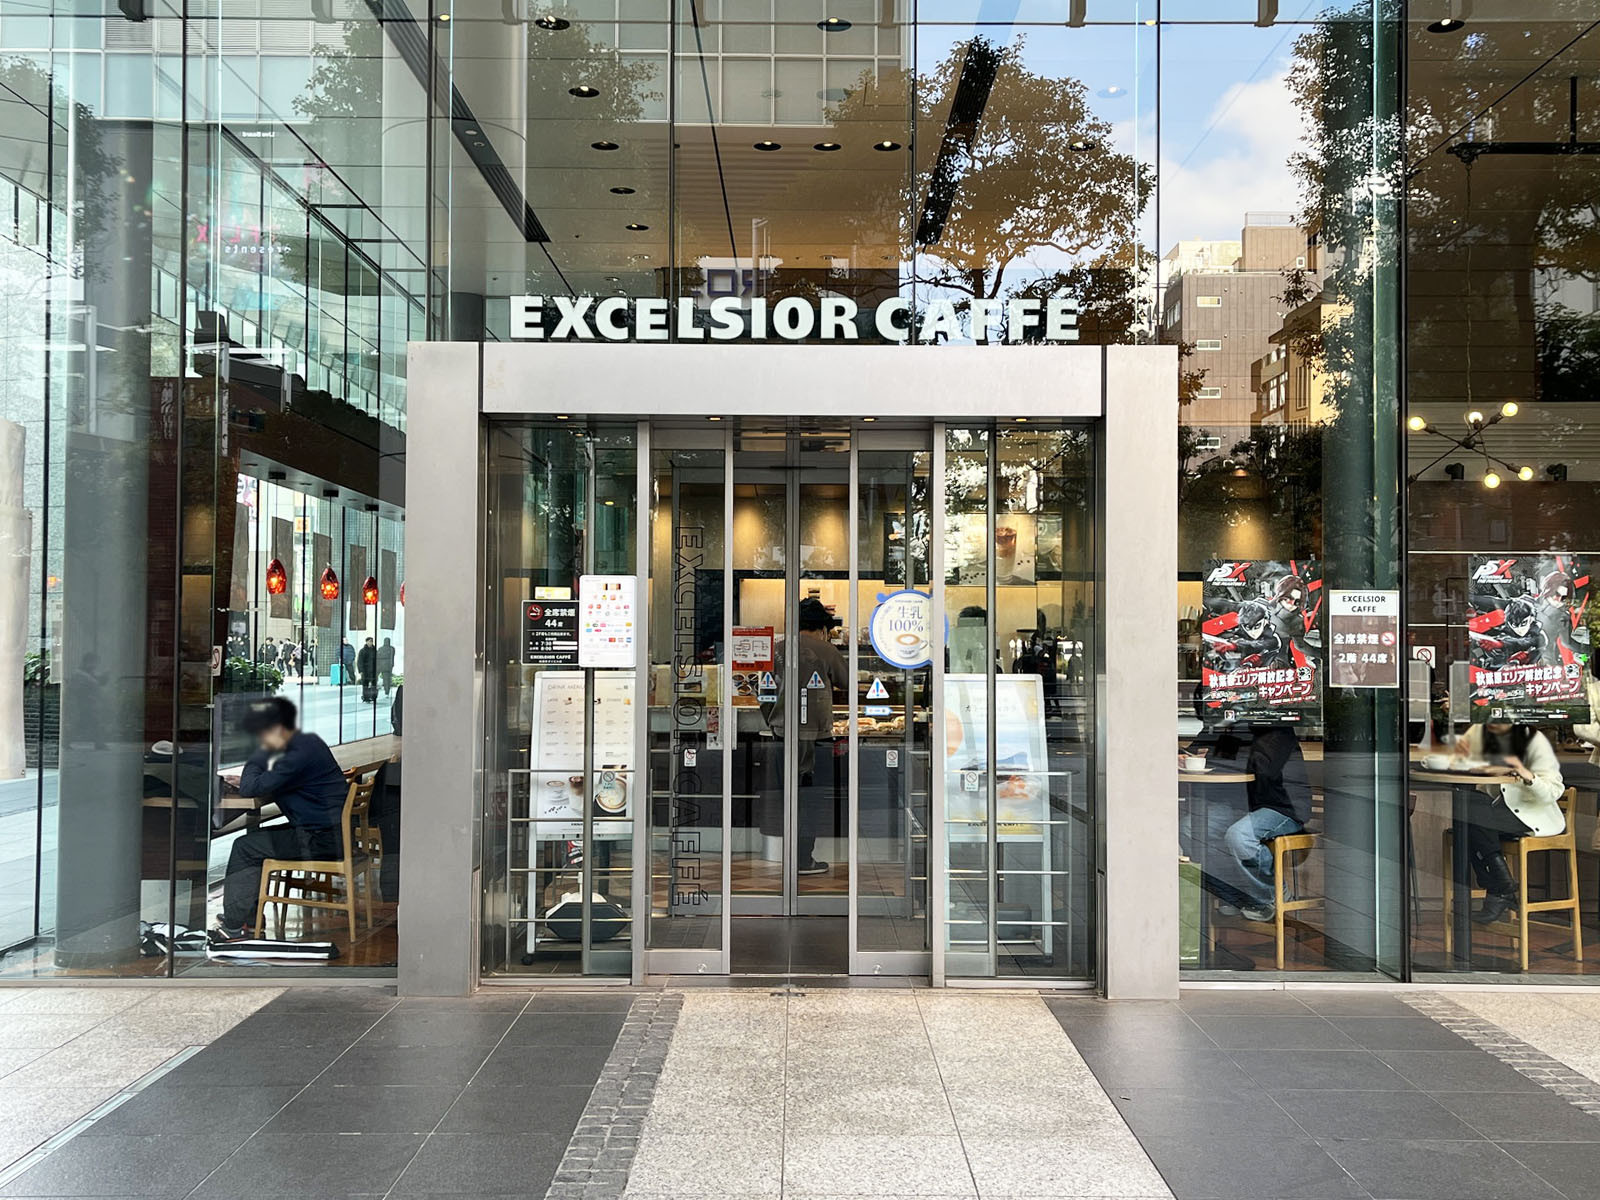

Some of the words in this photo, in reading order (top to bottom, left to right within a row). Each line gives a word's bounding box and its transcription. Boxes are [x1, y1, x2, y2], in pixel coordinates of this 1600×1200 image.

[508, 294, 859, 342] EXCELSIOR
[873, 286, 1080, 342] CAFFÉ
[1342, 595, 1386, 603] EXCELSIOR
[898, 605, 924, 619] 牛乳
[889, 619, 924, 632] 100%
[673, 526, 704, 755] EXCELSIOR
[1333, 633, 1380, 645] 全席禁煙
[1338, 652, 1358, 664] 2階
[1361, 652, 1388, 664] 44席
[1258, 682, 1312, 698] キャンペーン
[1525, 680, 1579, 696] キャンペーン
[671, 771, 709, 907] CAFFÉ
